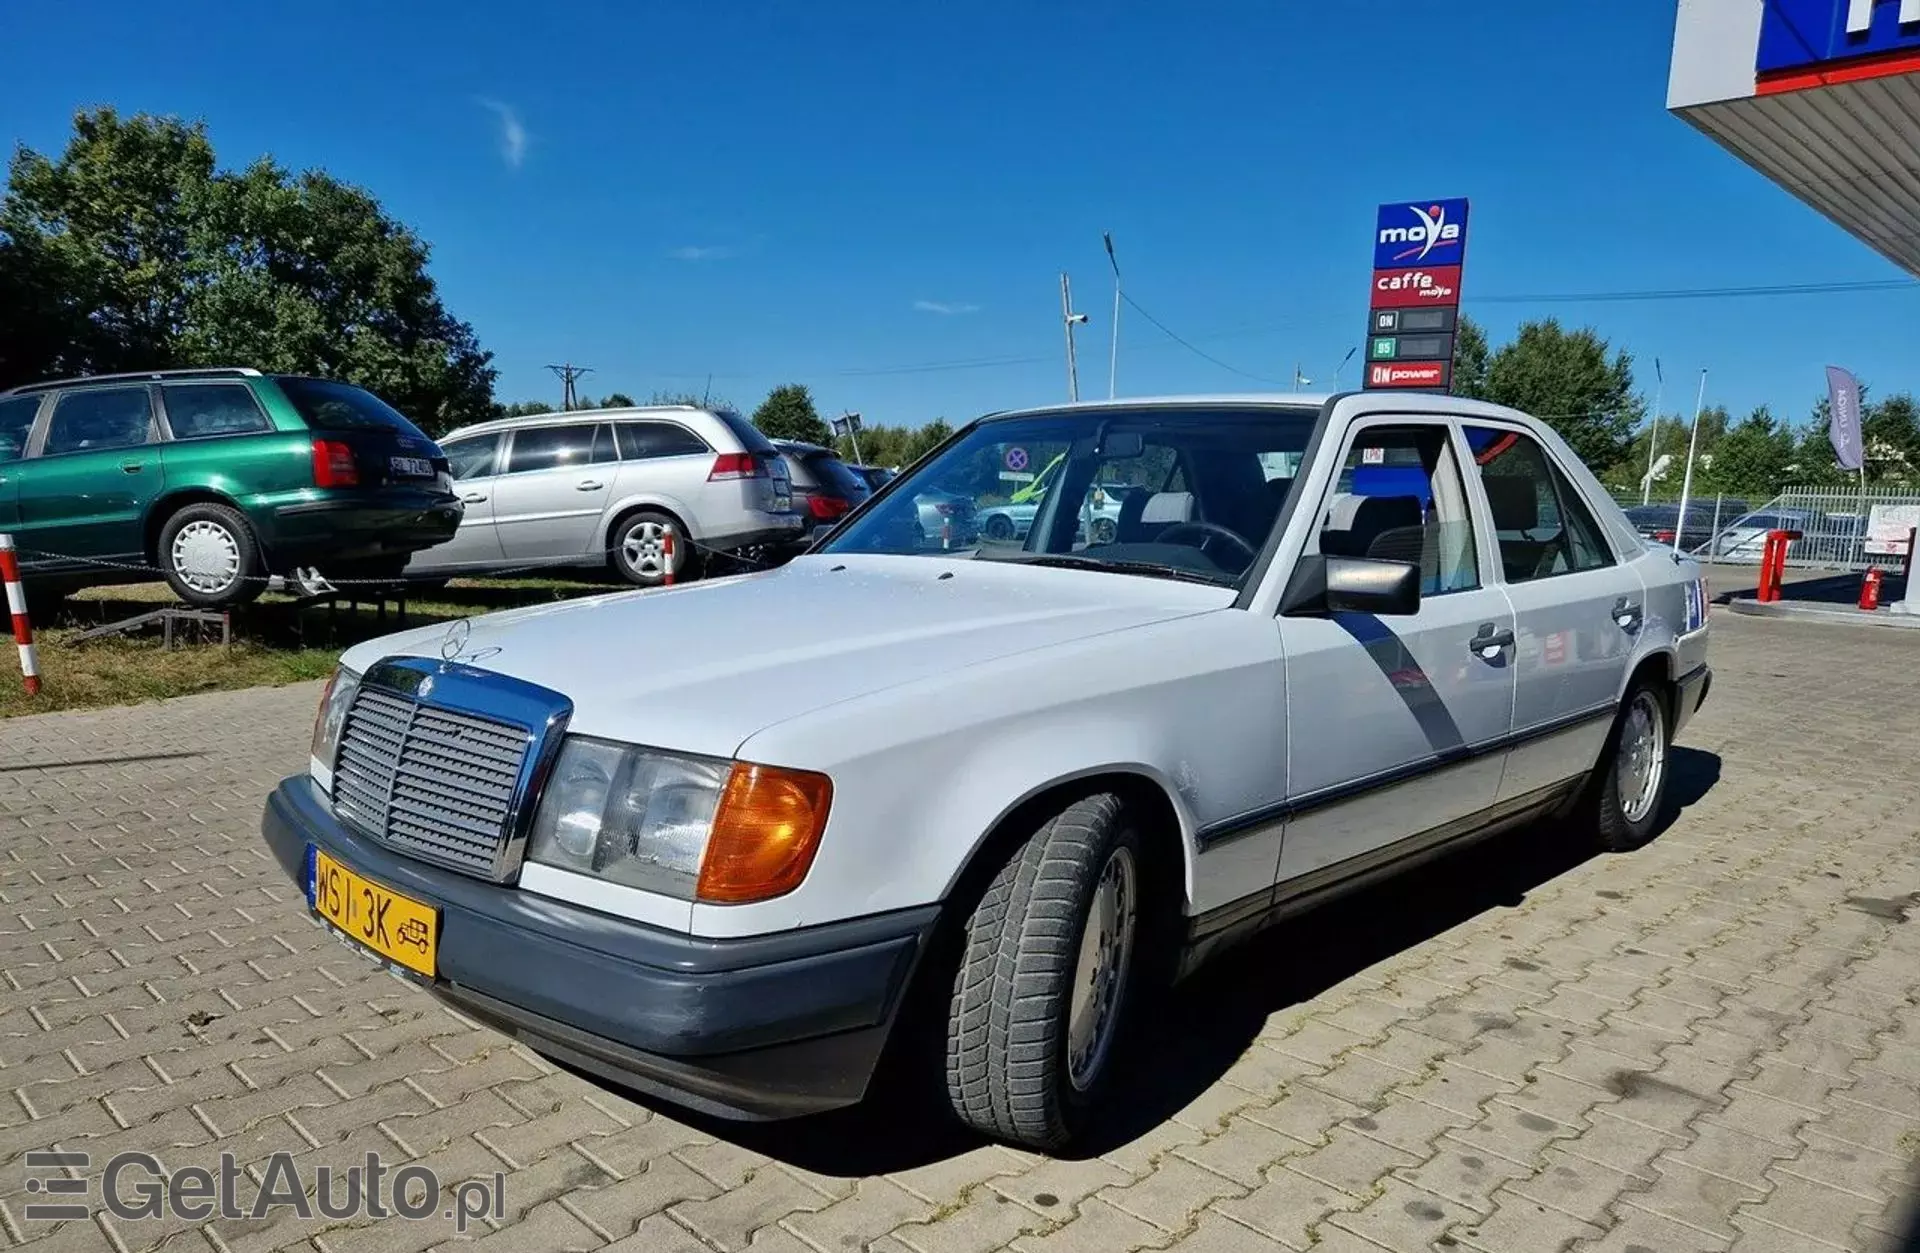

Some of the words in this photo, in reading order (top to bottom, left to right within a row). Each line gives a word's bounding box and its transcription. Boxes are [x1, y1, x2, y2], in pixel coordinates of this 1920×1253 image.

[1379, 206, 1460, 260] moya
[1377, 271, 1433, 290] caffe
[1418, 286, 1452, 299] moya
[1379, 314, 1394, 327] ON
[1377, 342, 1391, 354] 95
[1391, 369, 1440, 381] power
[318, 857, 351, 925] WSI
[362, 888, 392, 949] 3K
